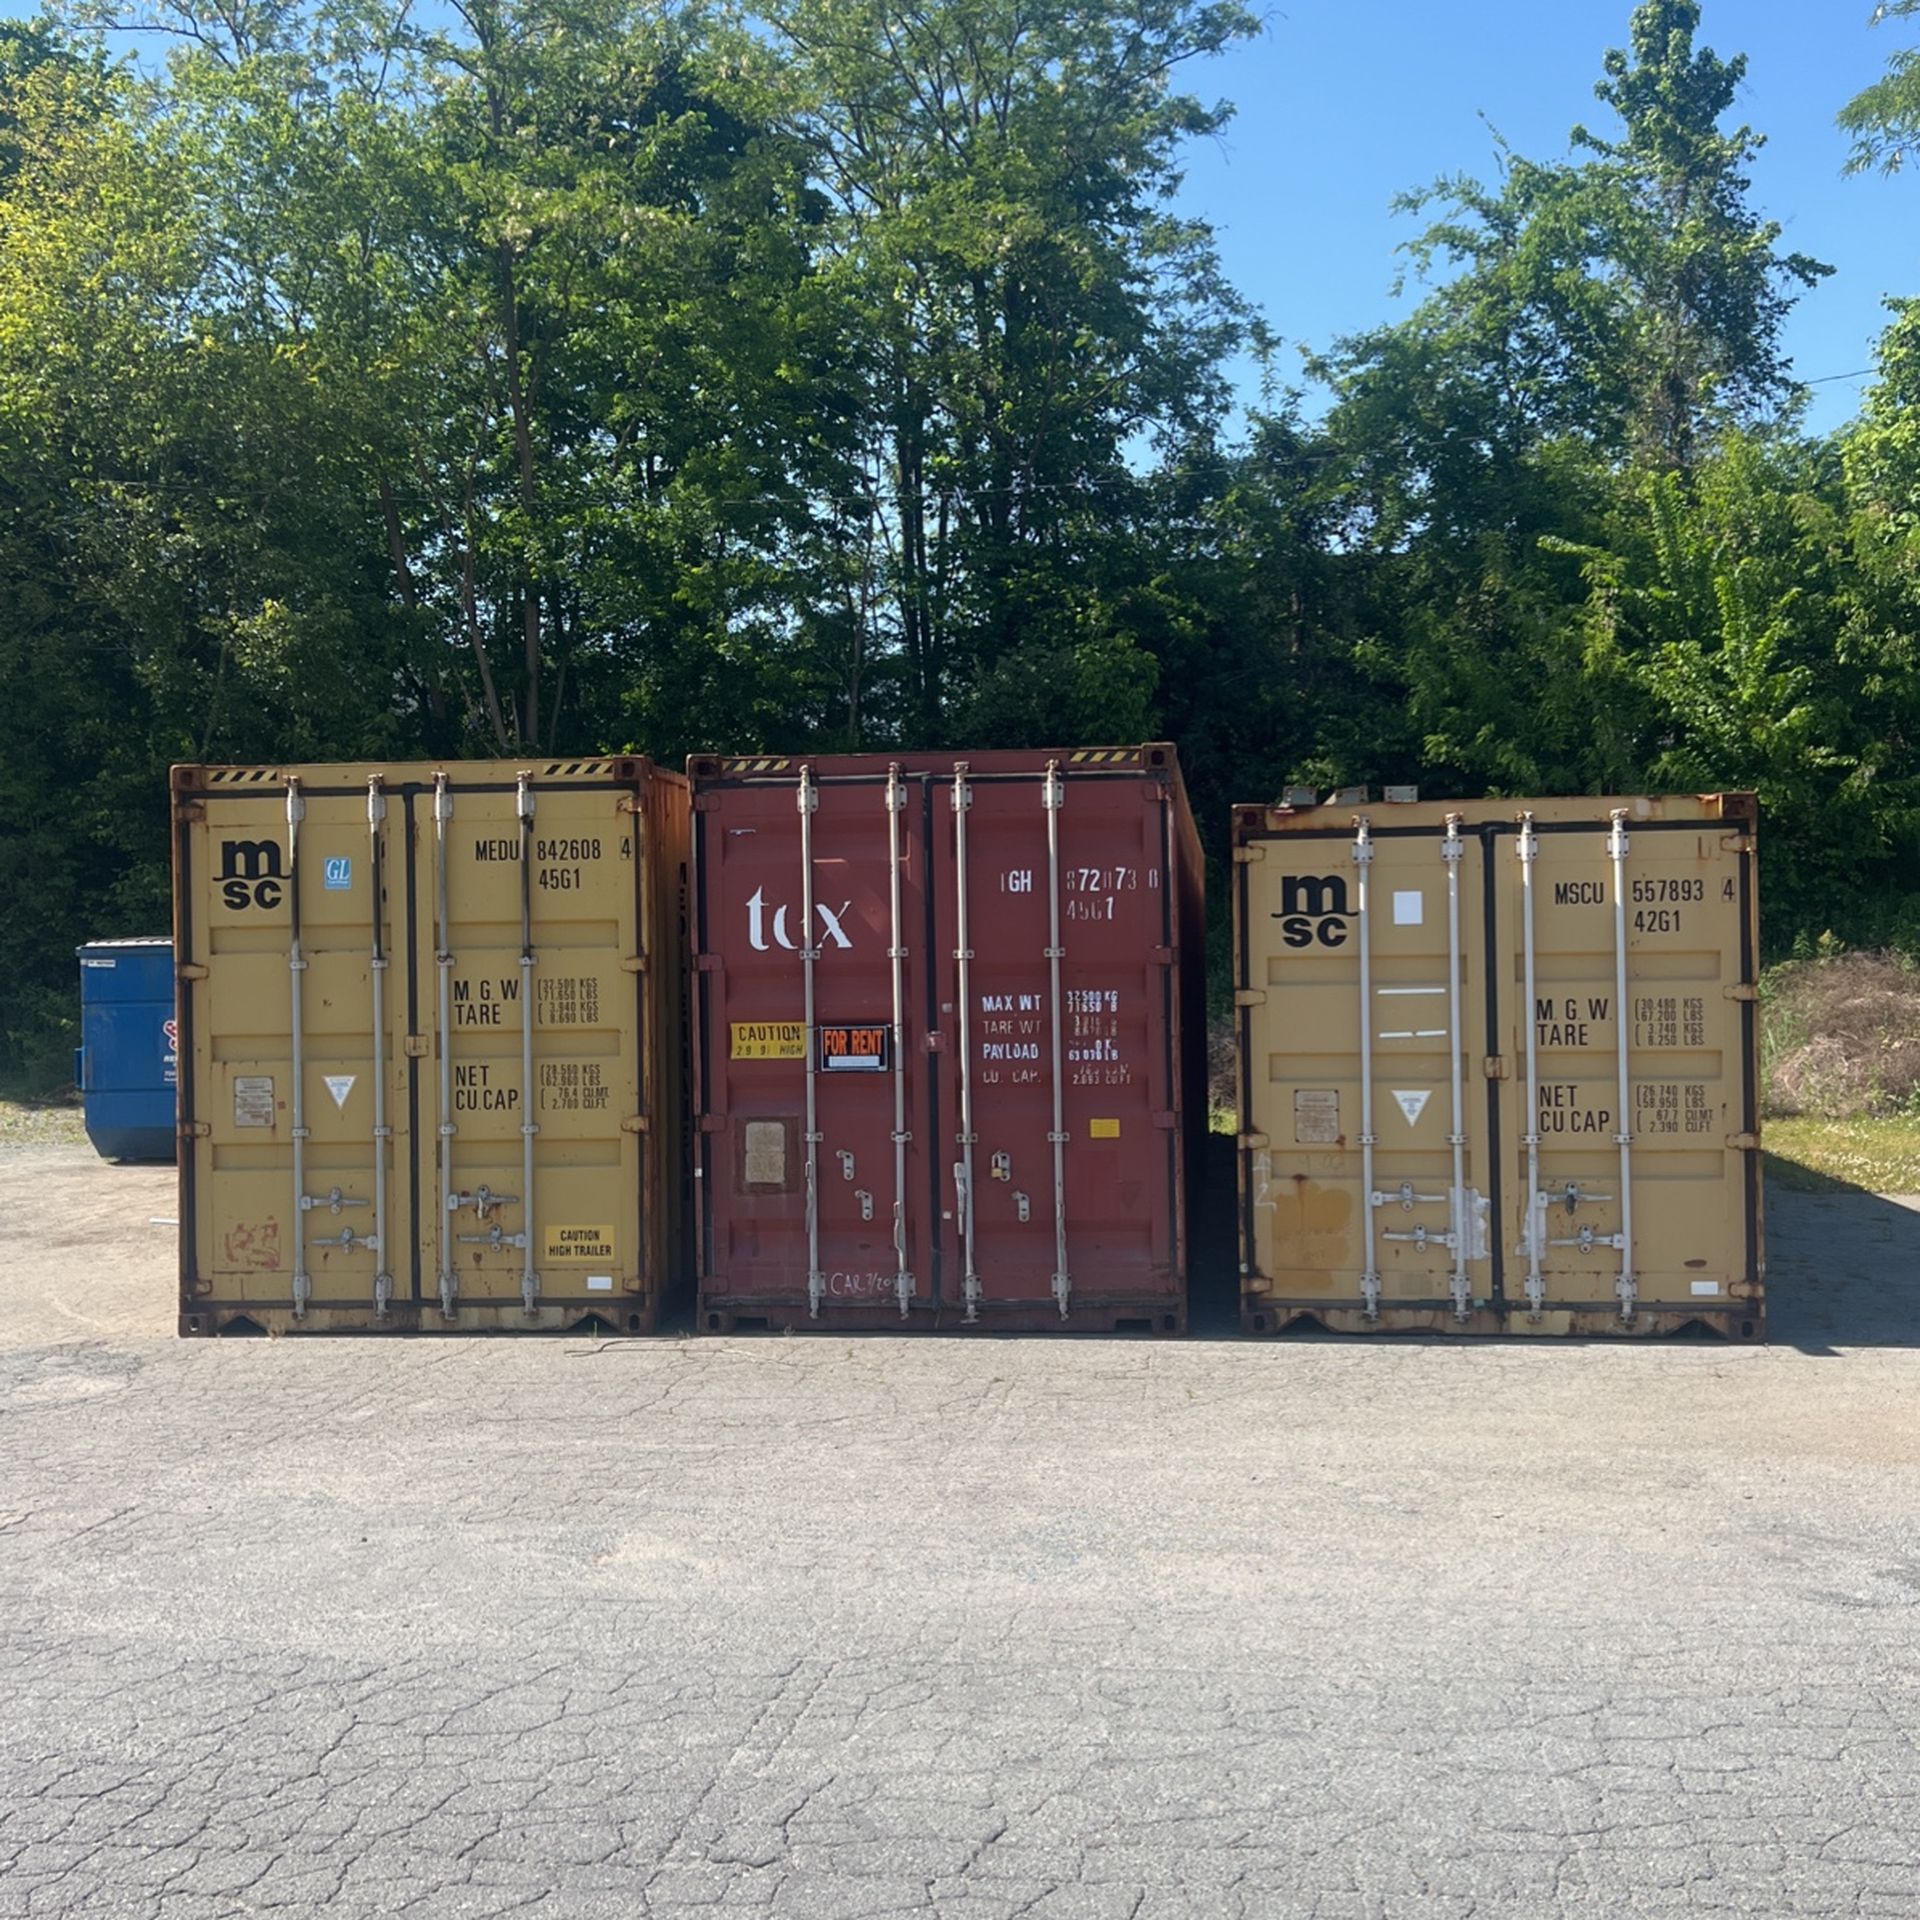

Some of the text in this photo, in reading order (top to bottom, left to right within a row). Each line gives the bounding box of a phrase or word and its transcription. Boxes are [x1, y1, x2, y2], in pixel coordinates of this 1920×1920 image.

[475, 838, 632, 861] MEDU 842608 4
[539, 868, 581, 890] 45G1
[1001, 870, 1032, 892] GH
[1555, 879, 1735, 905] MSCU 557893 4
[1634, 910, 1681, 933] 42G1
[580, 977, 597, 989] KGS
[580, 989, 598, 1000] LBS
[1104, 990, 1118, 1001] KG
[581, 1001, 599, 1012] KGS
[982, 995, 1042, 1013] MAX WT
[1683, 998, 1703, 1009] KGS
[454, 1004, 501, 1025] TARE
[581, 1012, 599, 1024] LBS
[1683, 1010, 1703, 1021] LBS
[738, 1025, 800, 1041] CAUTION
[983, 1020, 1042, 1035] TARE WT
[1683, 1023, 1704, 1034] KGS
[1537, 1024, 1588, 1046] TARE
[1684, 1034, 1704, 1046] LBS
[824, 1030, 883, 1056] FOR RENT
[983, 1043, 1039, 1060] PAYLOAD
[582, 1064, 600, 1074] KGS
[456, 1065, 489, 1086] NET
[583, 1075, 600, 1086] LBS
[1539, 1085, 1578, 1107] NET
[1684, 1084, 1704, 1096] KGS
[1685, 1096, 1704, 1108] LBS
[560, 1230, 600, 1242] CAUTION
[549, 1244, 612, 1256] HIGH TRAILER
